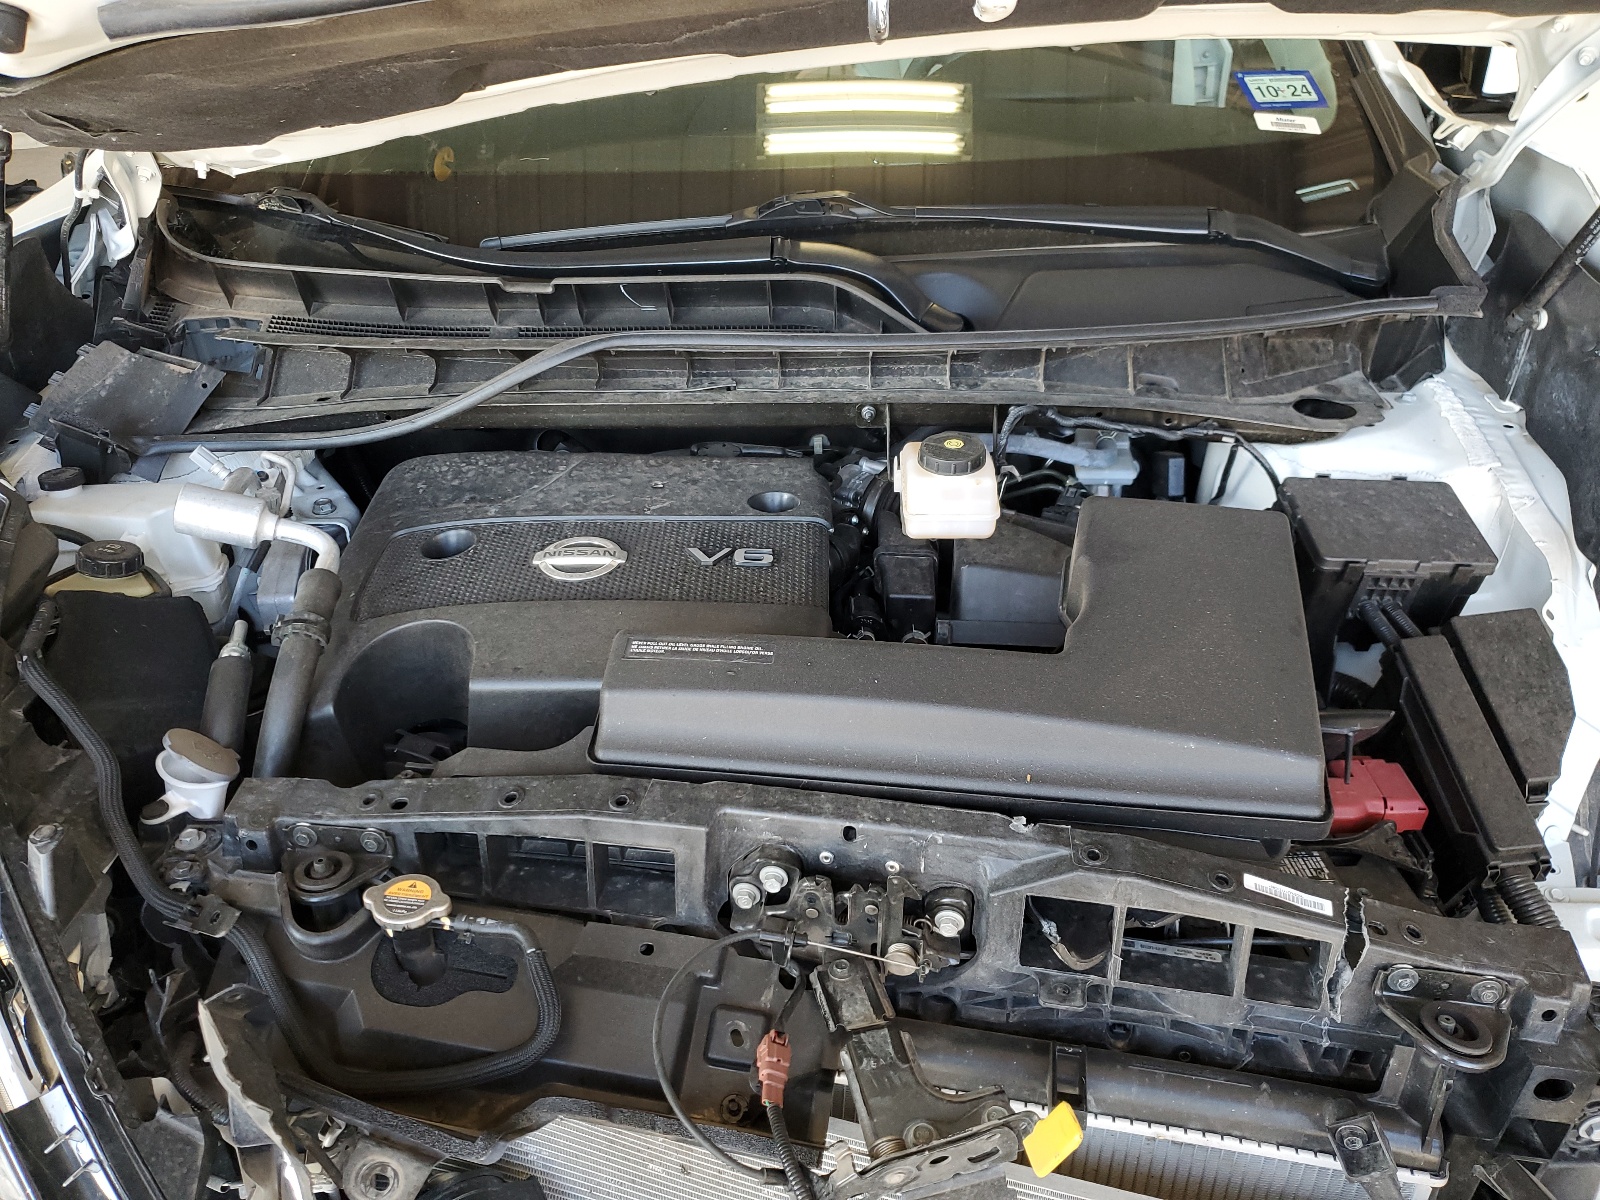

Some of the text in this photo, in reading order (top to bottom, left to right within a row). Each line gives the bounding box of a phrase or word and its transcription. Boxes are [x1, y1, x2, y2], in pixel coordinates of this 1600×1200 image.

[1255, 84, 1312, 98] 10 24
[543, 549, 617, 558] NISSAN
[688, 548, 774, 567] V6
